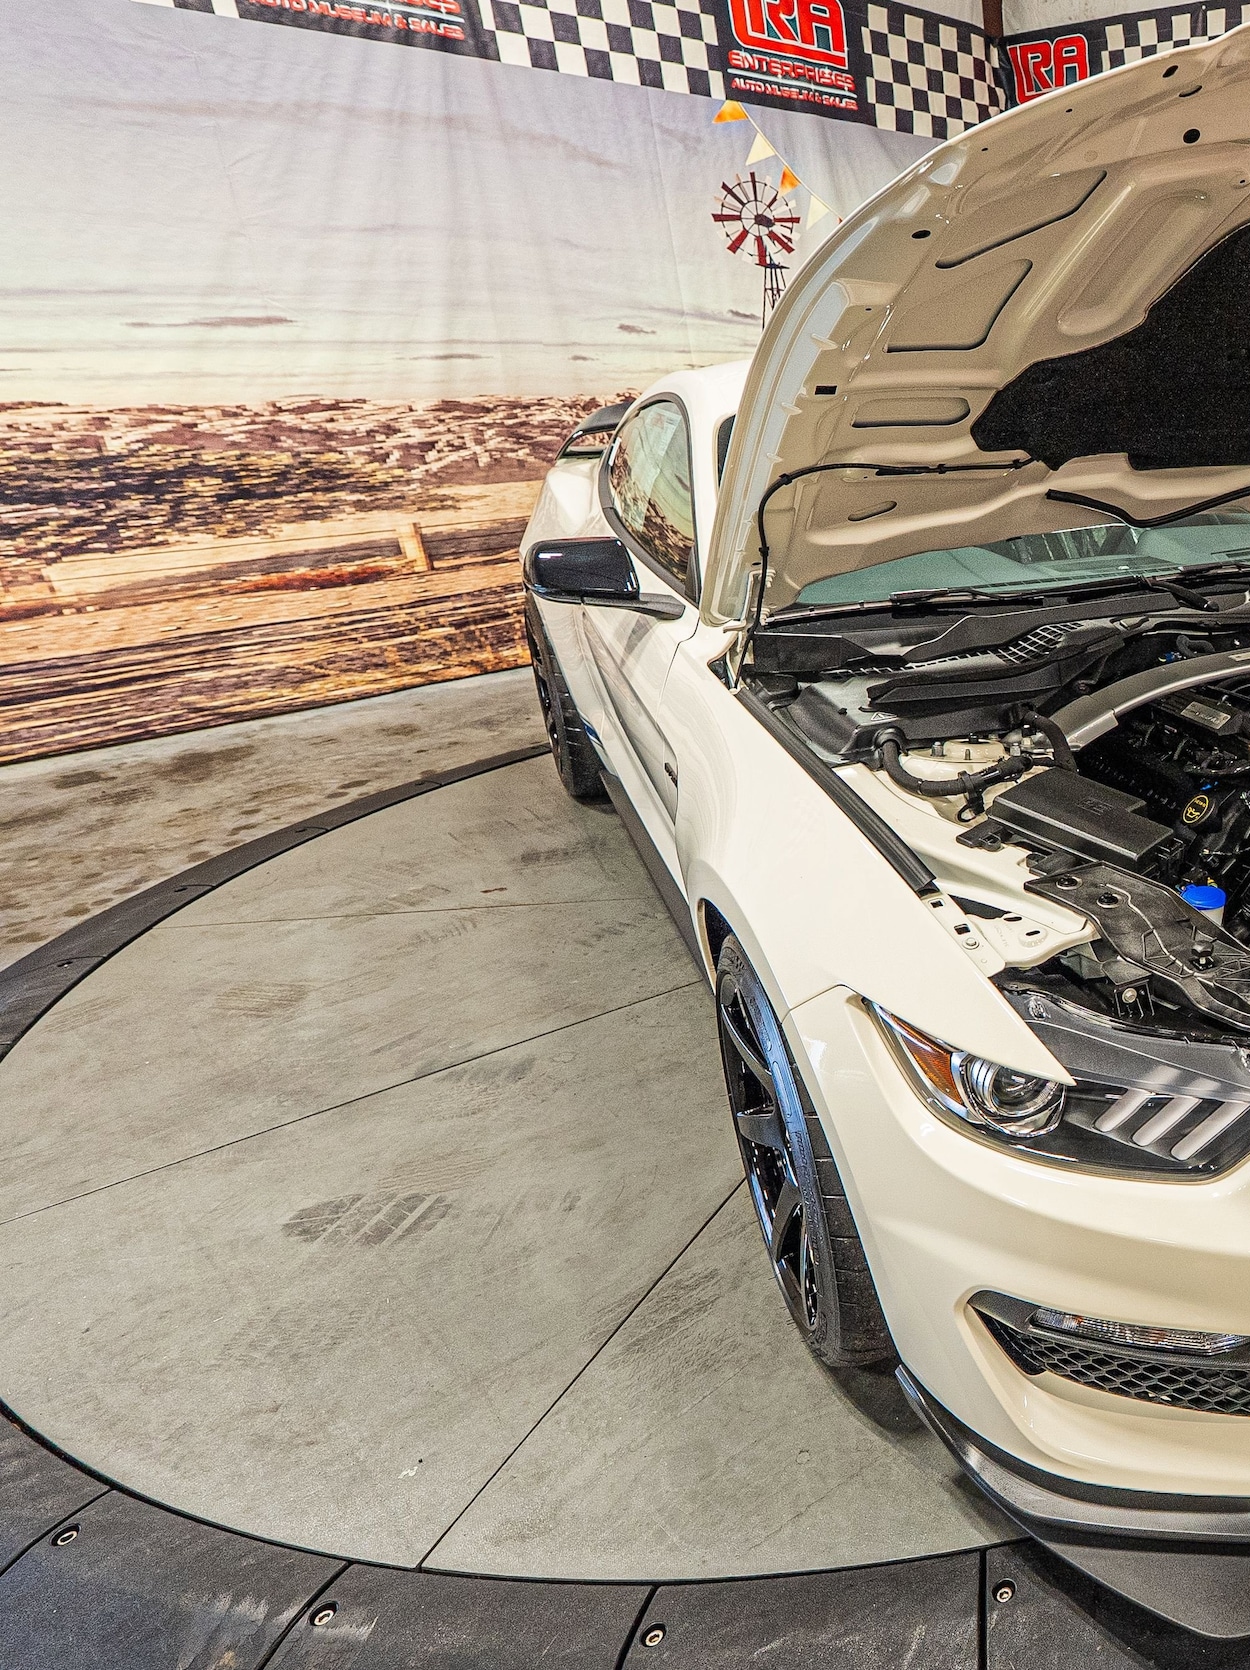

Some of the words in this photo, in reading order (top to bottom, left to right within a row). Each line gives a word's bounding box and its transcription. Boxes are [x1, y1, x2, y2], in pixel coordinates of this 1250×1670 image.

[307, 0, 393, 27] MUSEUM
[394, 14, 408, 30] &
[408, 17, 465, 41] SALES
[728, 49, 856, 92] ENTERPRISES
